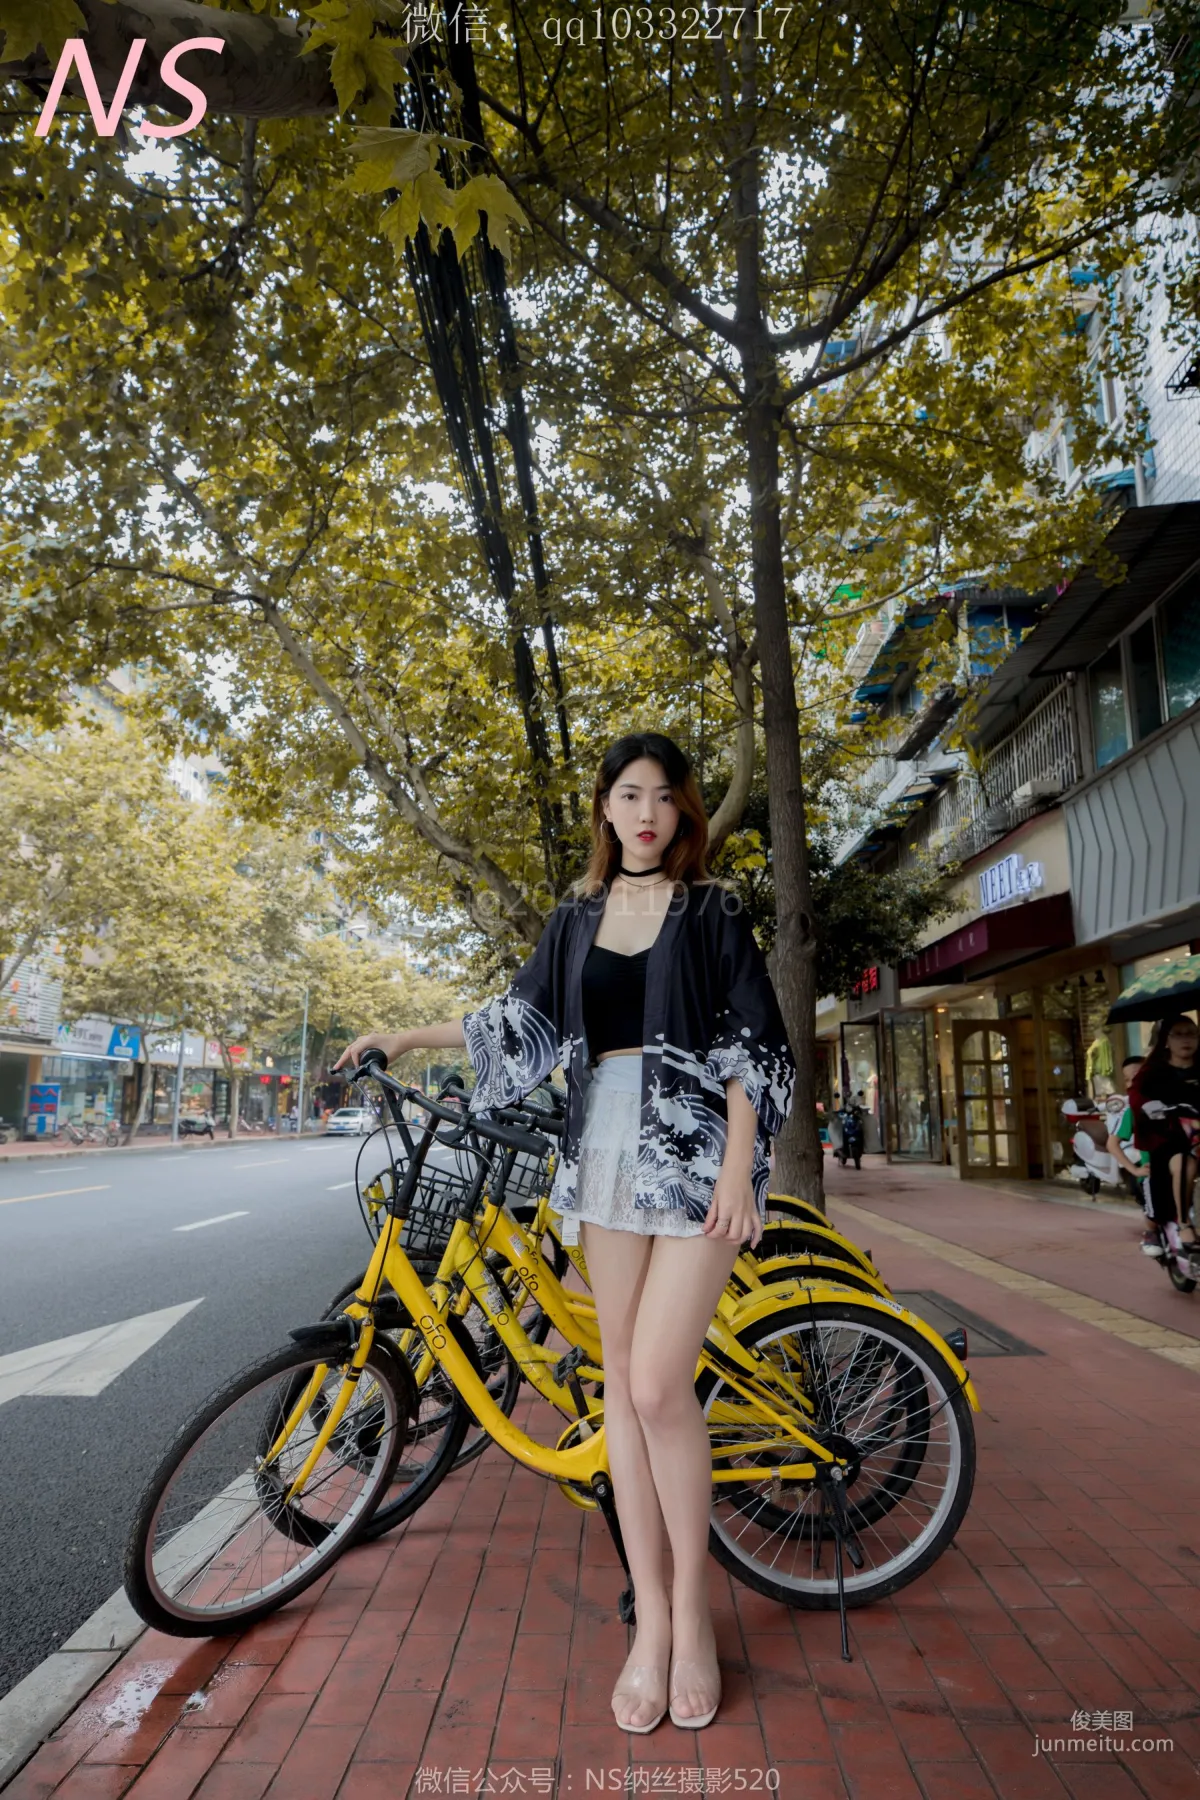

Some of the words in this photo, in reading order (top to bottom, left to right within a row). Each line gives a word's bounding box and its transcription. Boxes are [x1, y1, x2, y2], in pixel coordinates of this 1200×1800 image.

[979, 856, 1013, 910] MEET
[519, 1266, 539, 1292] ofo
[419, 1315, 447, 1349] ofo
